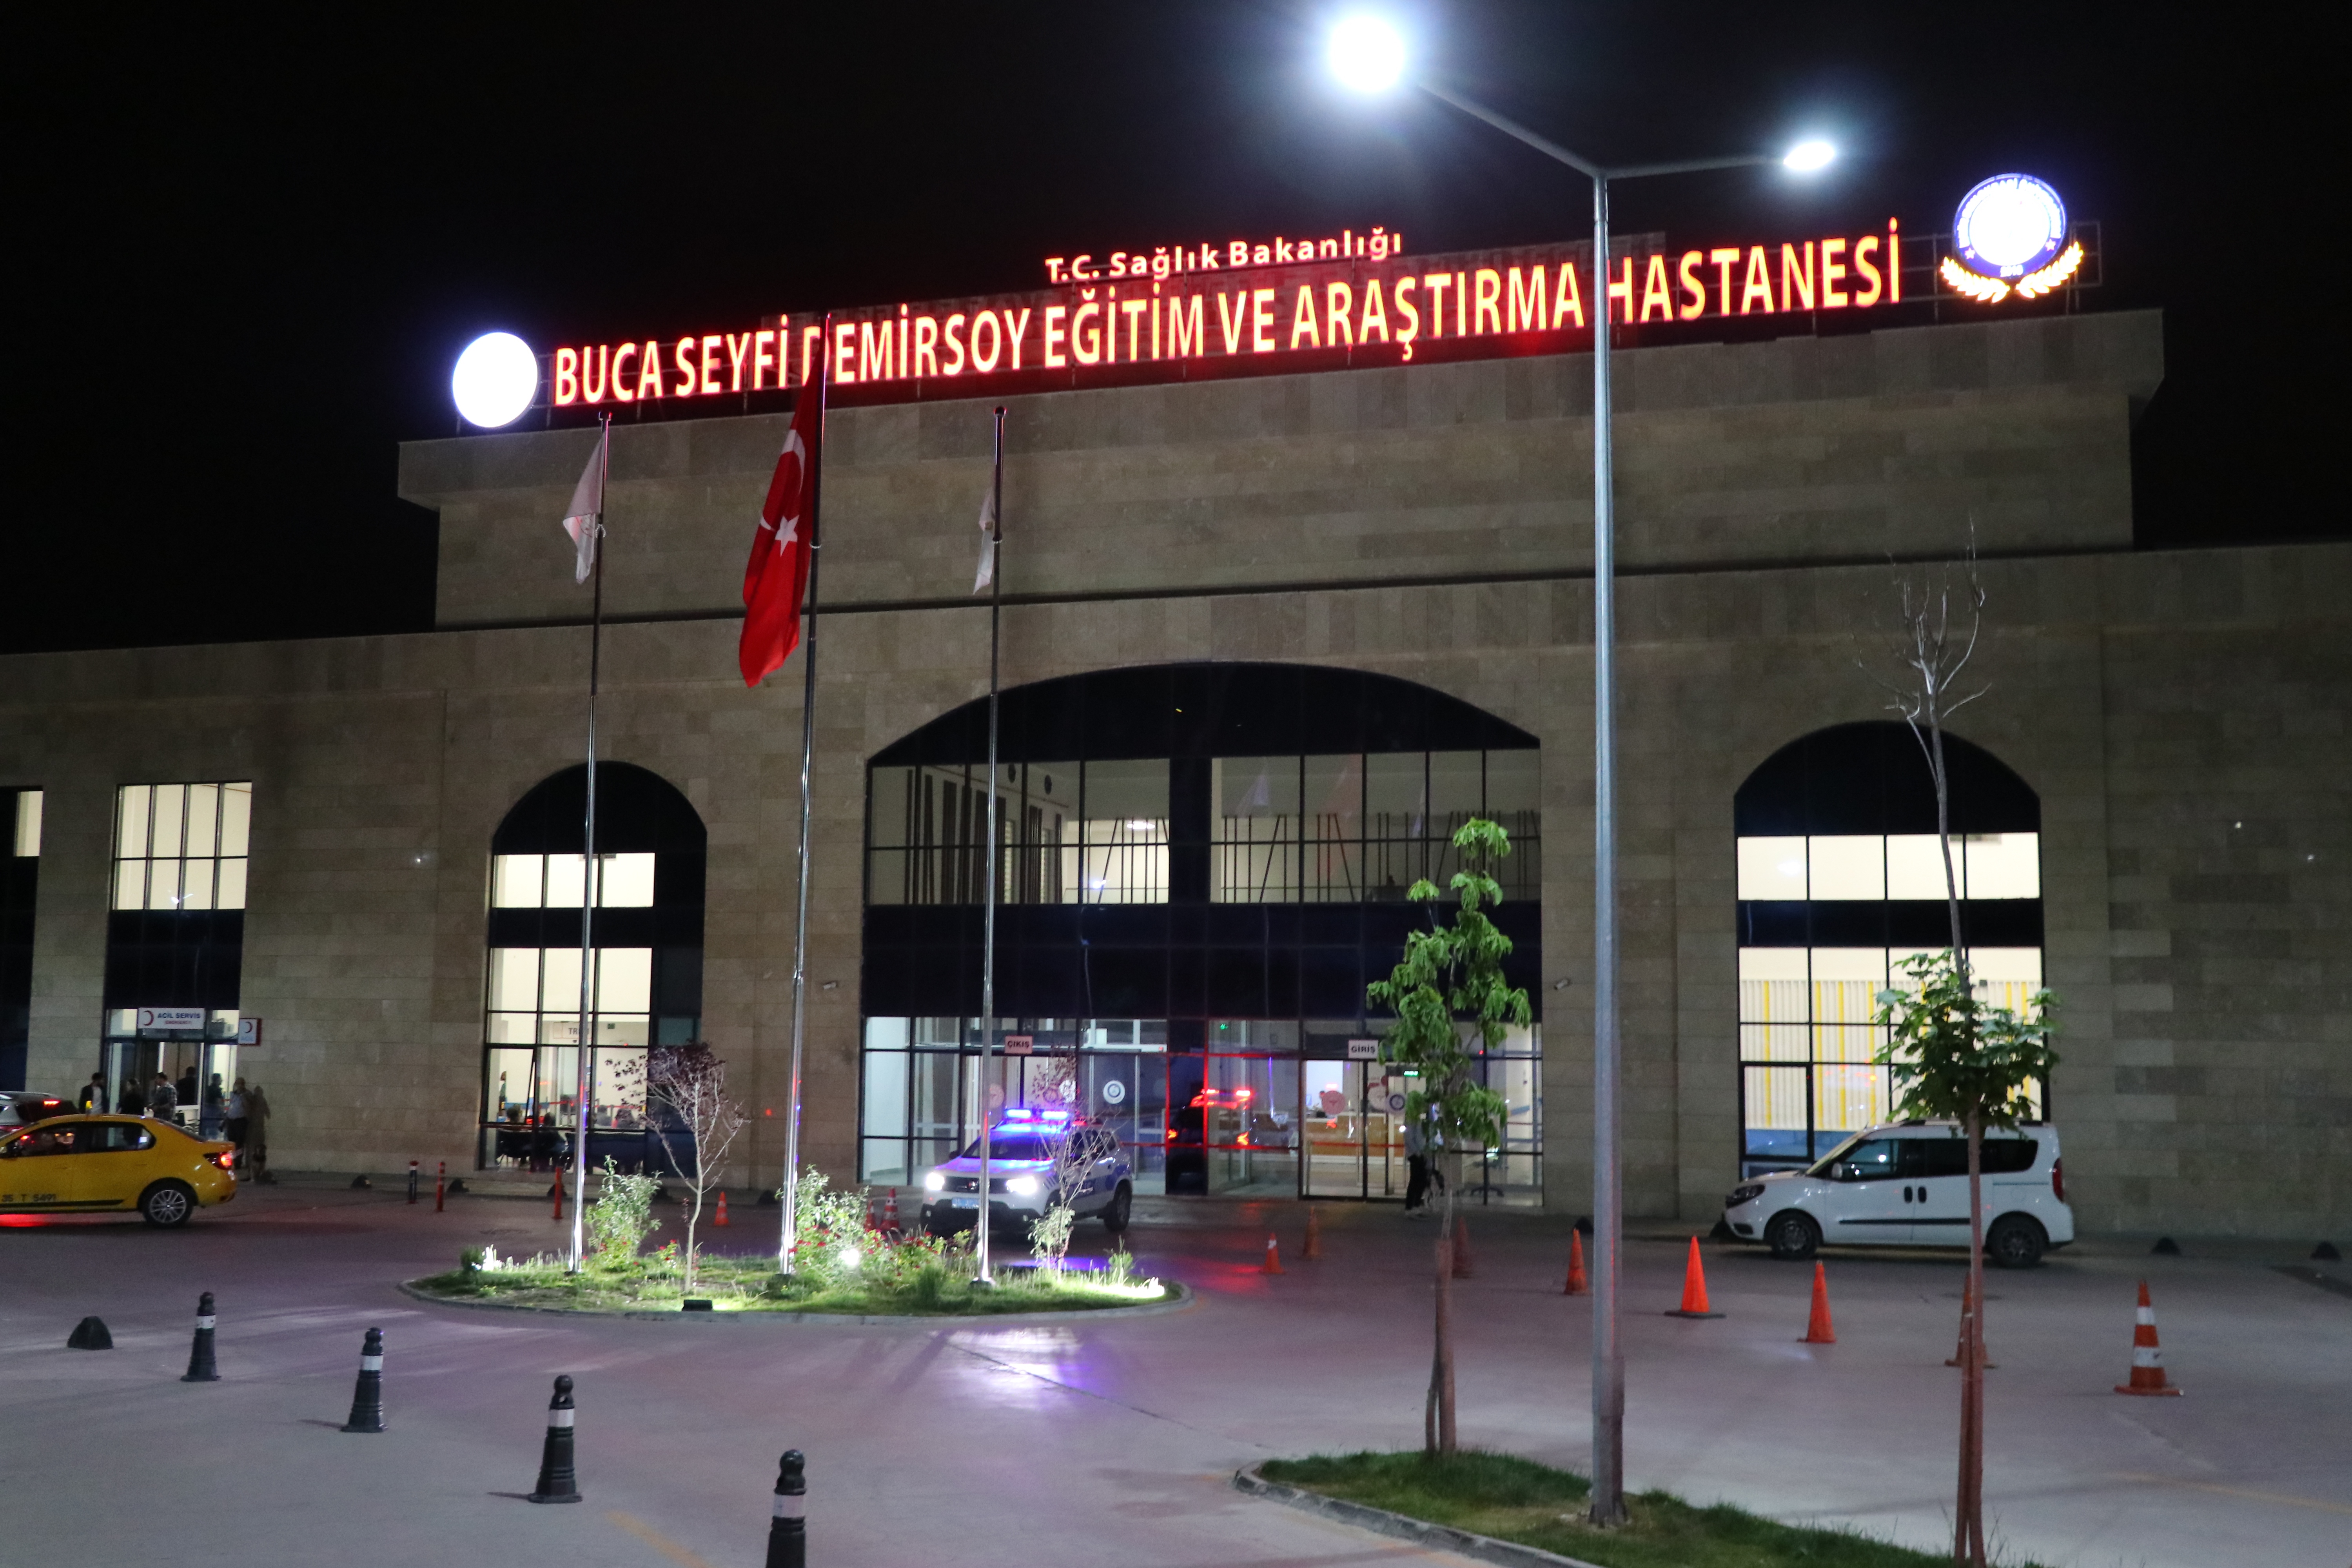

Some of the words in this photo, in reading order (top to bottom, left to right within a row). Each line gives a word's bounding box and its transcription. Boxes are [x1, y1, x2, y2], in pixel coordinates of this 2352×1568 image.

[1045, 254, 1100, 283] T.C.
[1109, 242, 1220, 282] Sağlık
[1228, 226, 1401, 268] Bakanlığı
[554, 340, 663, 407] BUCA
[674, 314, 789, 398] SEYFİ
[801, 303, 1031, 389] DEMİRSOY
[1043, 281, 1204, 370] EĞİTİM
[1216, 287, 1276, 356] VE
[1289, 261, 1585, 362] ARAŞTIRMA
[1606, 216, 1900, 325] HASTANESİ
[1007, 1040, 1030, 1049] ÇIKIŞ
[1351, 1044, 1376, 1054] GİRİŞ
[21, 1194, 27, 1202] T
